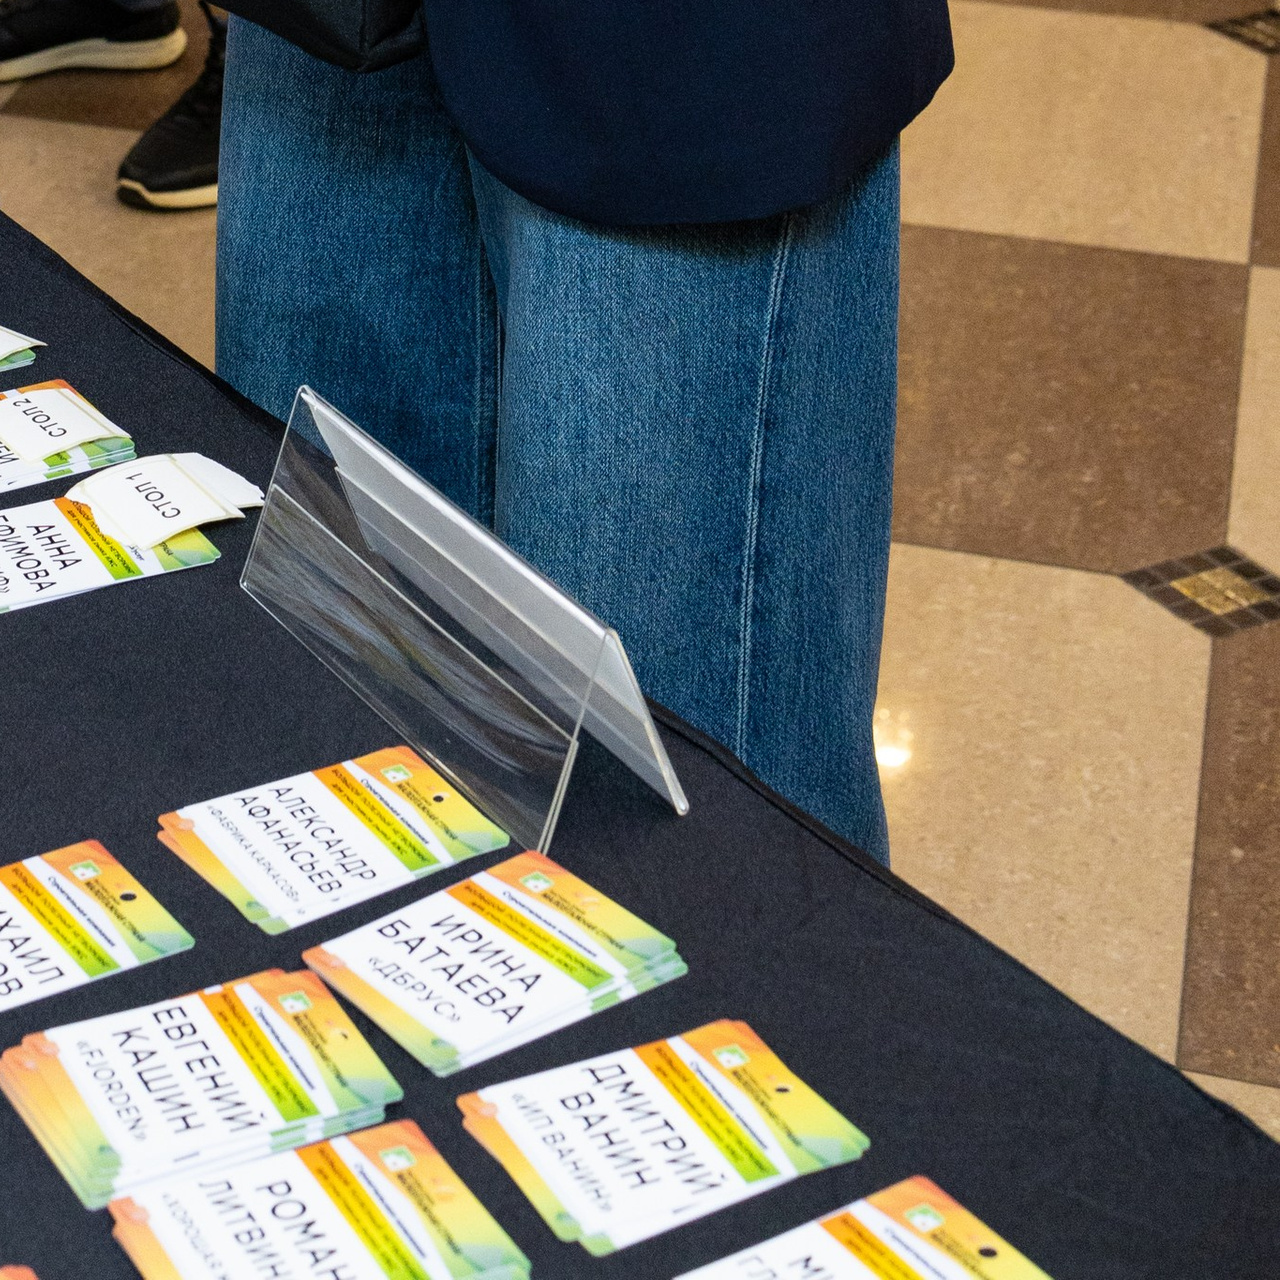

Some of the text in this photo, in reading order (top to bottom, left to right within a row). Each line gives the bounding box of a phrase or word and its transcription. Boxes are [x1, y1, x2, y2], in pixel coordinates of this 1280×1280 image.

[12, 398, 67, 438] 2 СТОЛ
[126, 472, 181, 519] 1 СТОЛ
[27, 526, 82, 570] АННА
[240, 797, 342, 892] АФАНАСЬЕВ
[274, 788, 376, 878] АЛЕКСАНДР
[369, 958, 460, 1021] «ДБРУС»
[377, 920, 524, 1023] БАТАЕВА
[431, 915, 541, 992] ИРИНА
[77, 1042, 145, 1139] «FJORDEN»
[113, 1028, 202, 1132] КАШИН
[153, 1007, 263, 1127] ЕВГЕНИЙ
[560, 1092, 647, 1185] ВАНИН
[586, 1064, 724, 1189] ДМИТРИЙ
